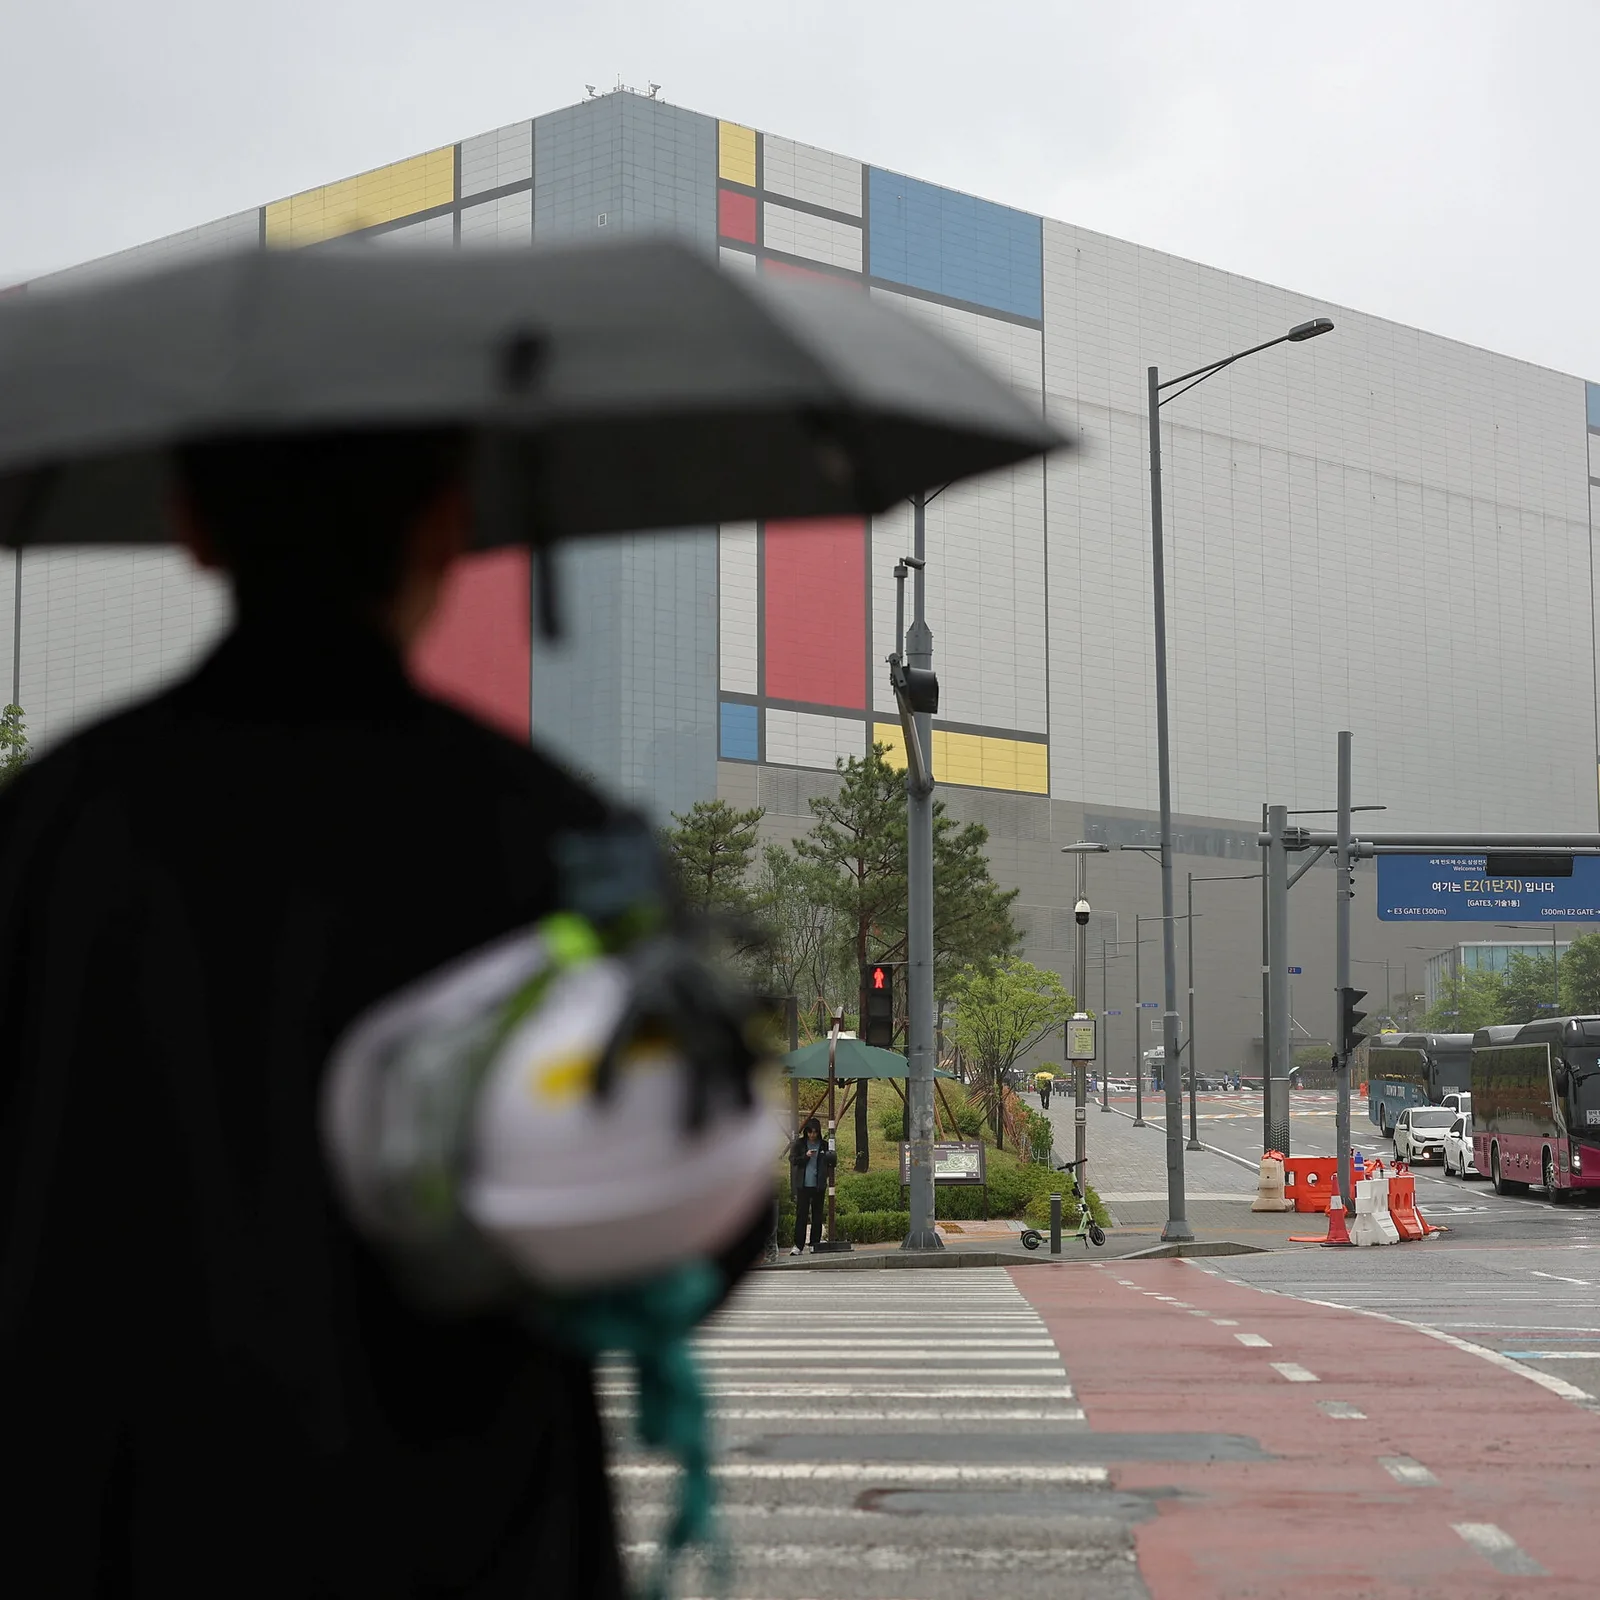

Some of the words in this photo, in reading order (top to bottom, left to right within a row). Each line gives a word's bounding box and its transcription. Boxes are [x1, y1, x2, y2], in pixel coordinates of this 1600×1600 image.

[1432, 882, 1461, 892] 여기는
[1464, 880, 1522, 892] E2(1단지)
[1525, 882, 1554, 892] 입니다
[1468, 900, 1492, 908] [GATE3,
[1422, 908, 1446, 916] (300m)
[1541, 908, 1566, 916] (300m)
